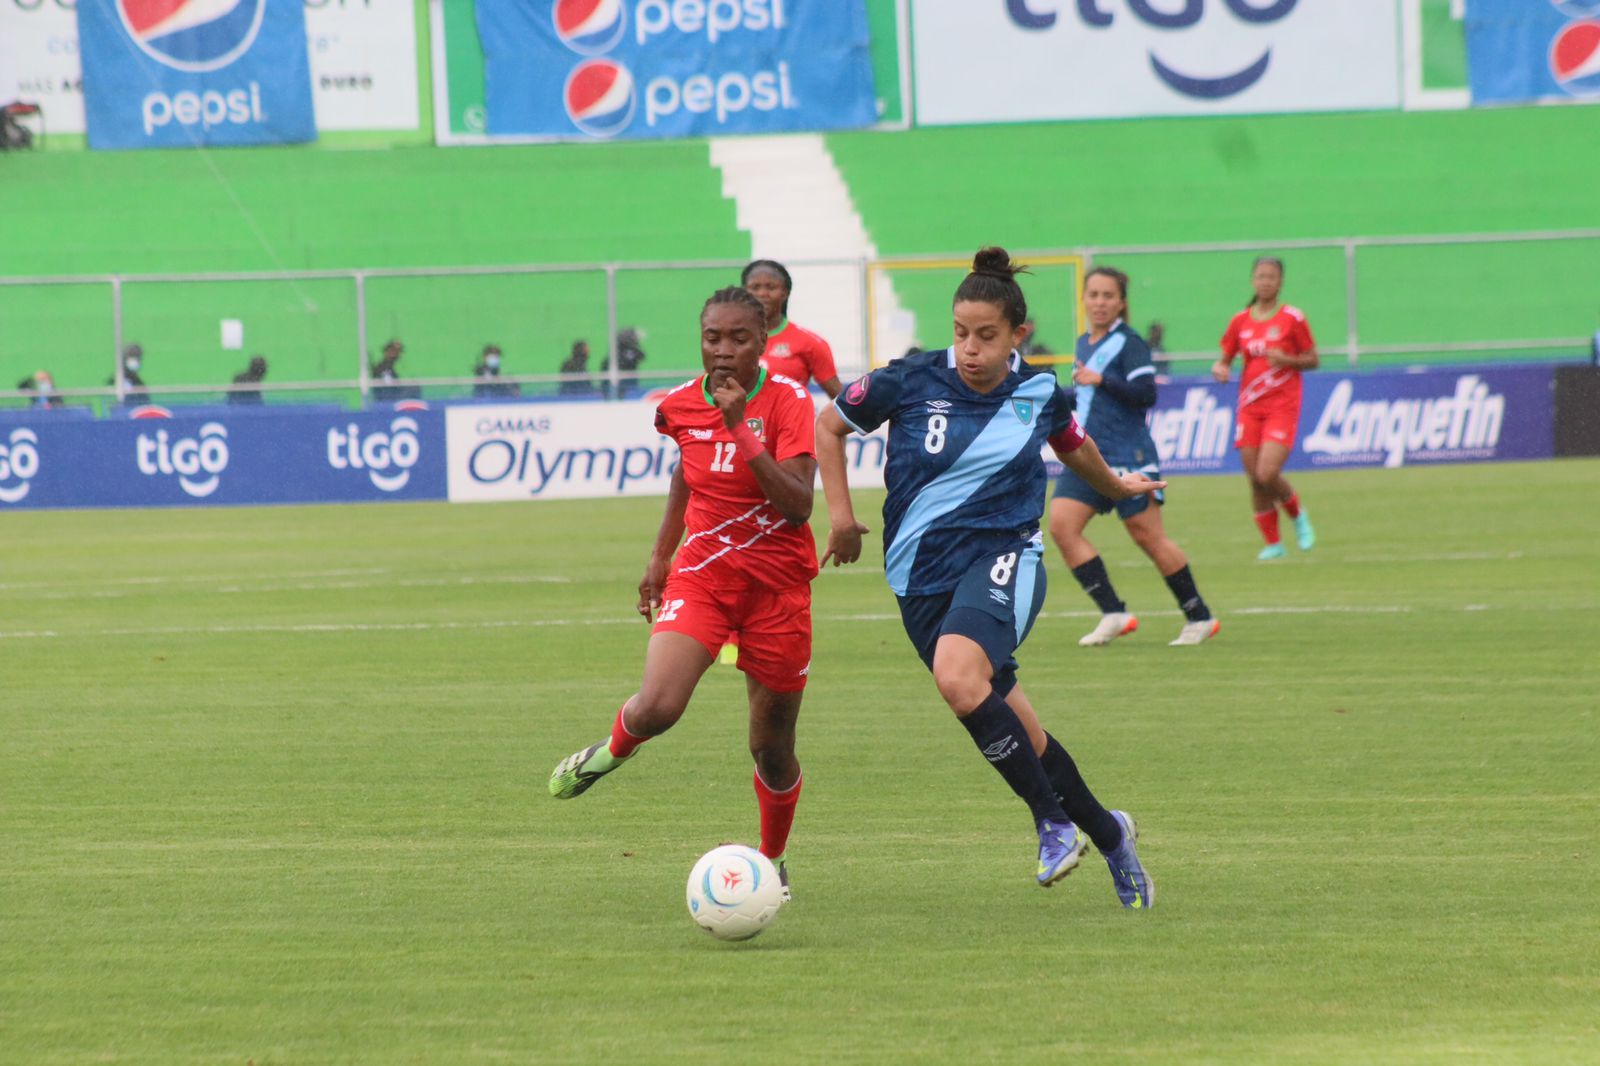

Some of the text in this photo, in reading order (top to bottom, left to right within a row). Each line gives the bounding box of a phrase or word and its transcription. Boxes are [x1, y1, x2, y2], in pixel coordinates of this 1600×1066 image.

[636, 0, 784, 46] pepsi
[142, 81, 262, 136] pepsi
[646, 60, 791, 127] pepsi
[476, 418, 551, 435] CAMAS
[924, 414, 947, 454] 8
[710, 442, 736, 473] 12
[990, 552, 1016, 585] 8
